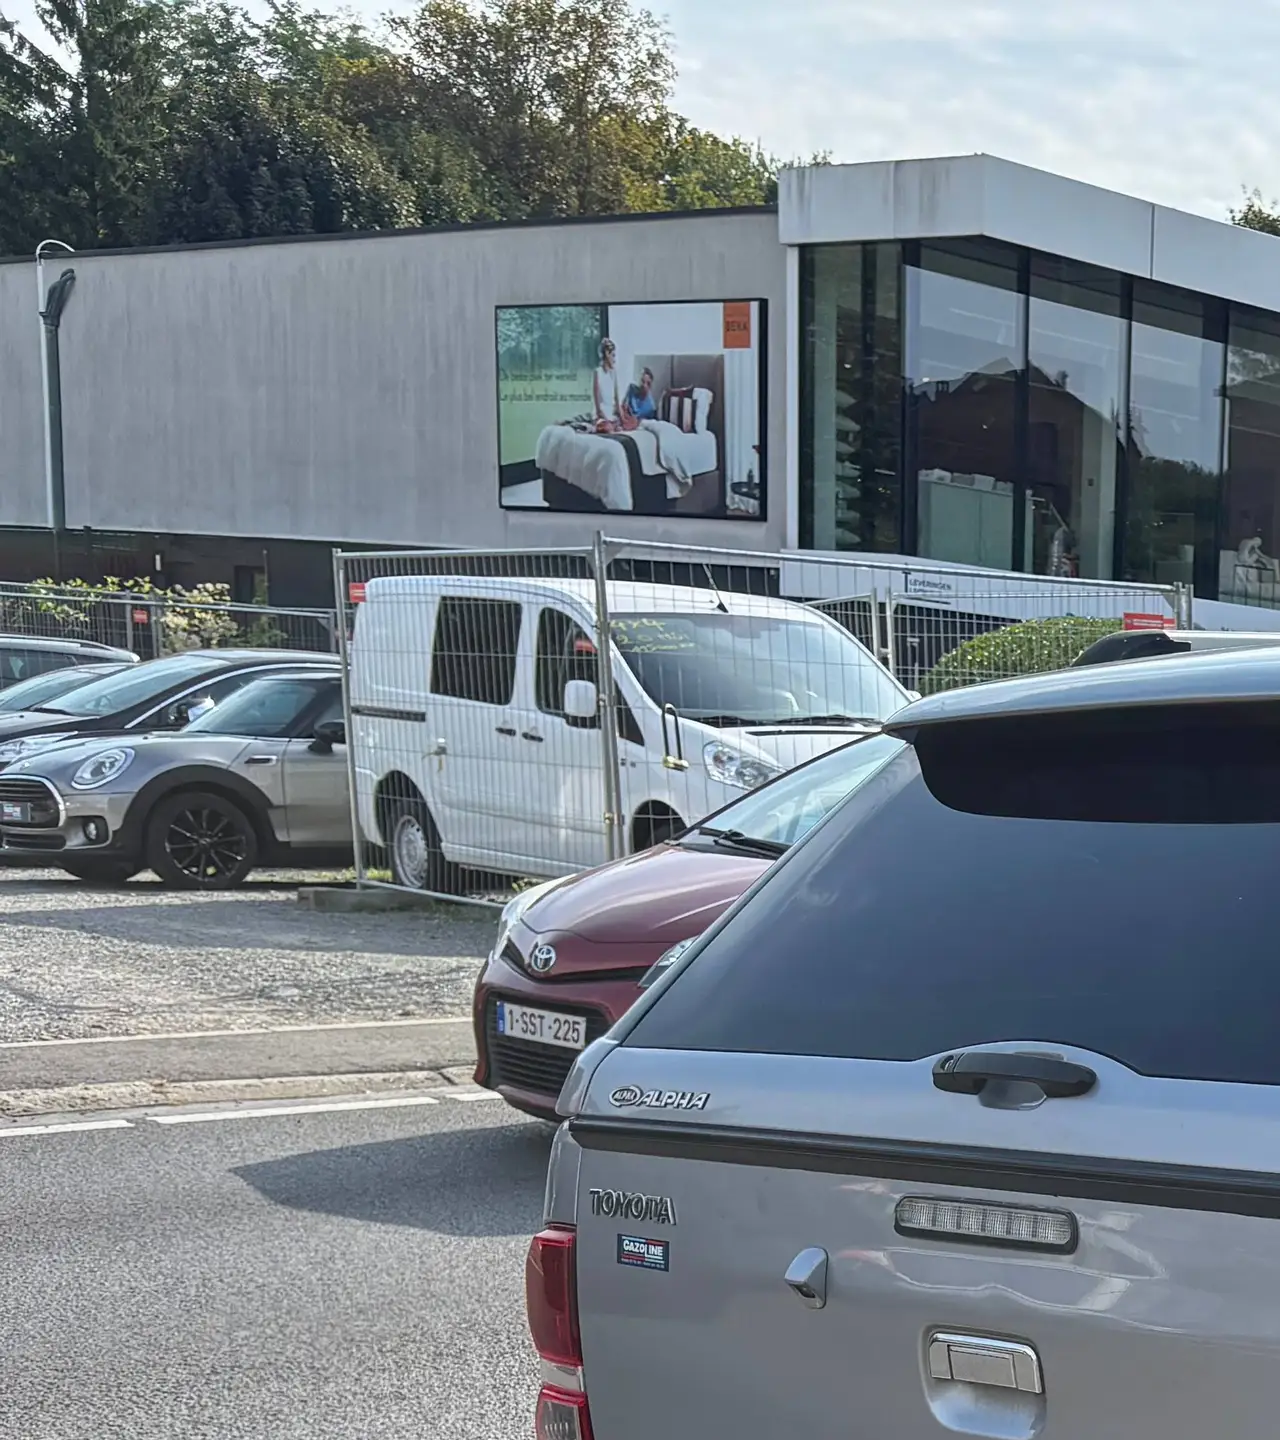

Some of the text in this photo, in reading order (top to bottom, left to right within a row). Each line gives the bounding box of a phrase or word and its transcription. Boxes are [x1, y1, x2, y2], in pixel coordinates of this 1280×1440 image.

[507, 1008, 581, 1044] 1-SST-225
[635, 1089, 711, 1110] ALPHA
[588, 1187, 678, 1226] TOYOTA
[623, 1239, 664, 1260] GAZOLINE
